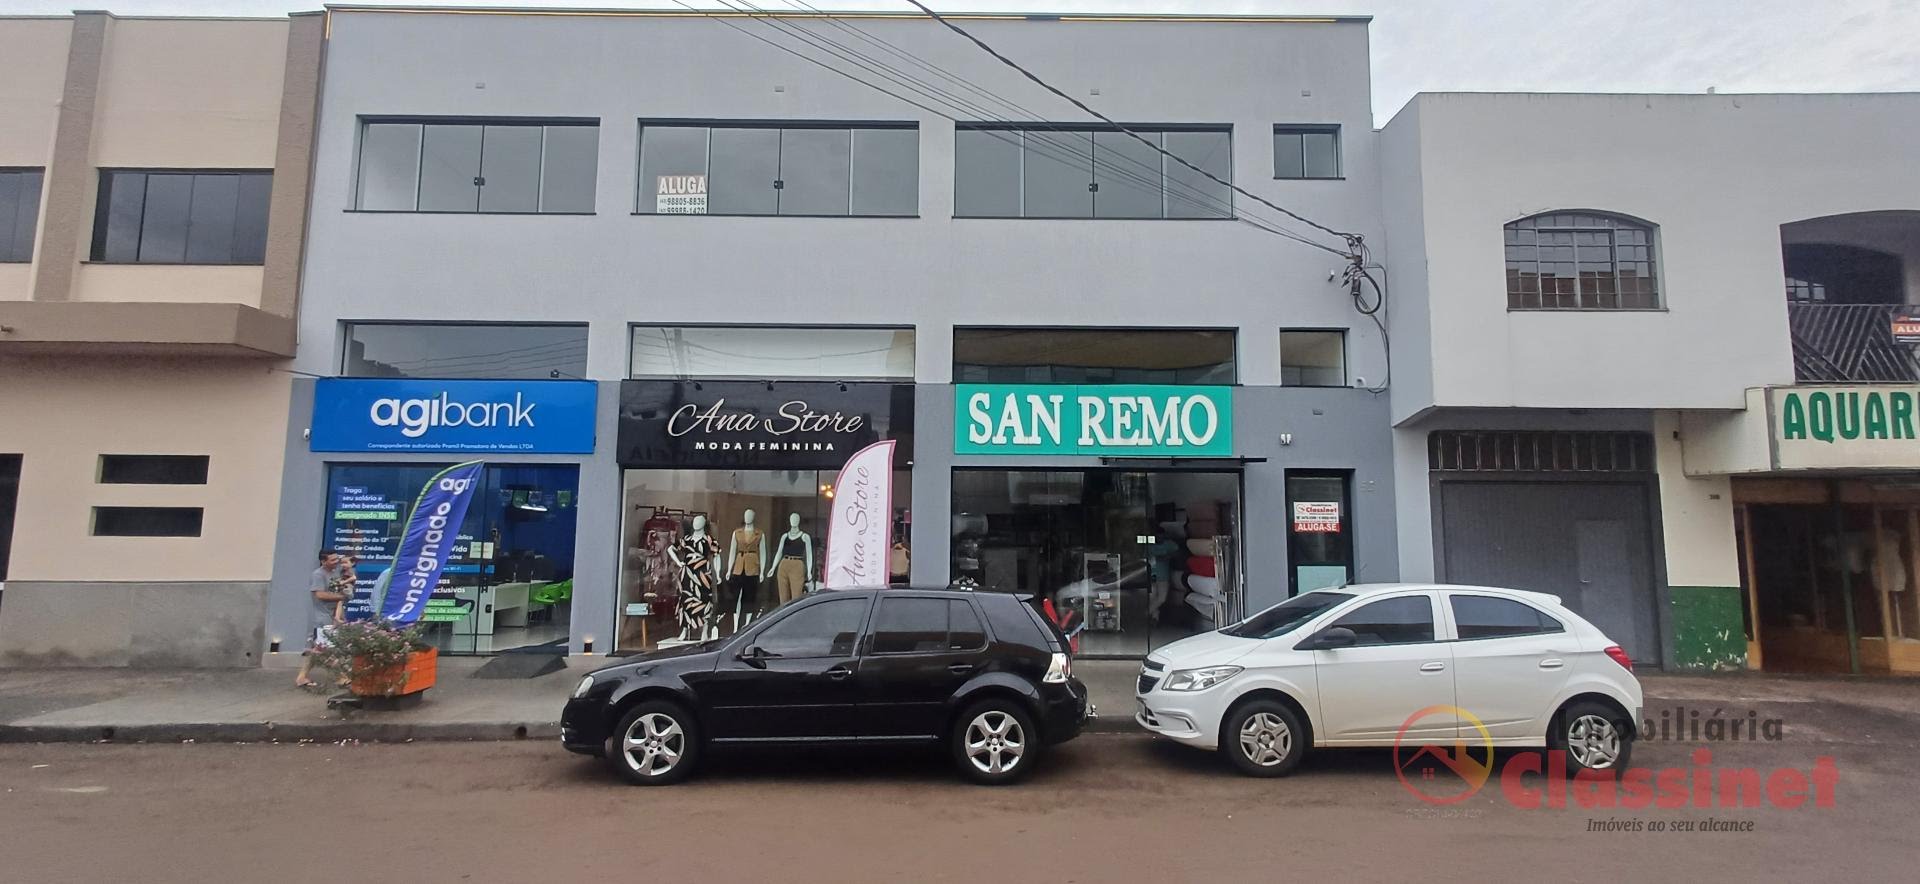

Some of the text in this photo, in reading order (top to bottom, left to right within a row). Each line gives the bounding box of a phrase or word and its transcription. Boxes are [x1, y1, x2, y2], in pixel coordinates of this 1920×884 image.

[659, 176, 707, 194] ALUGA
[370, 391, 537, 438] agibank
[667, 398, 864, 437] Ana Store
[968, 392, 1218, 446] SAN REMO
[1783, 391, 1920, 444] AQUAR
[367, 442, 411, 450] Correspondente
[695, 442, 835, 451] MODA FEMININA
[343, 486, 363, 494] Traga
[845, 465, 869, 536] Store
[1298, 523, 1338, 532] ALUGA-SE
